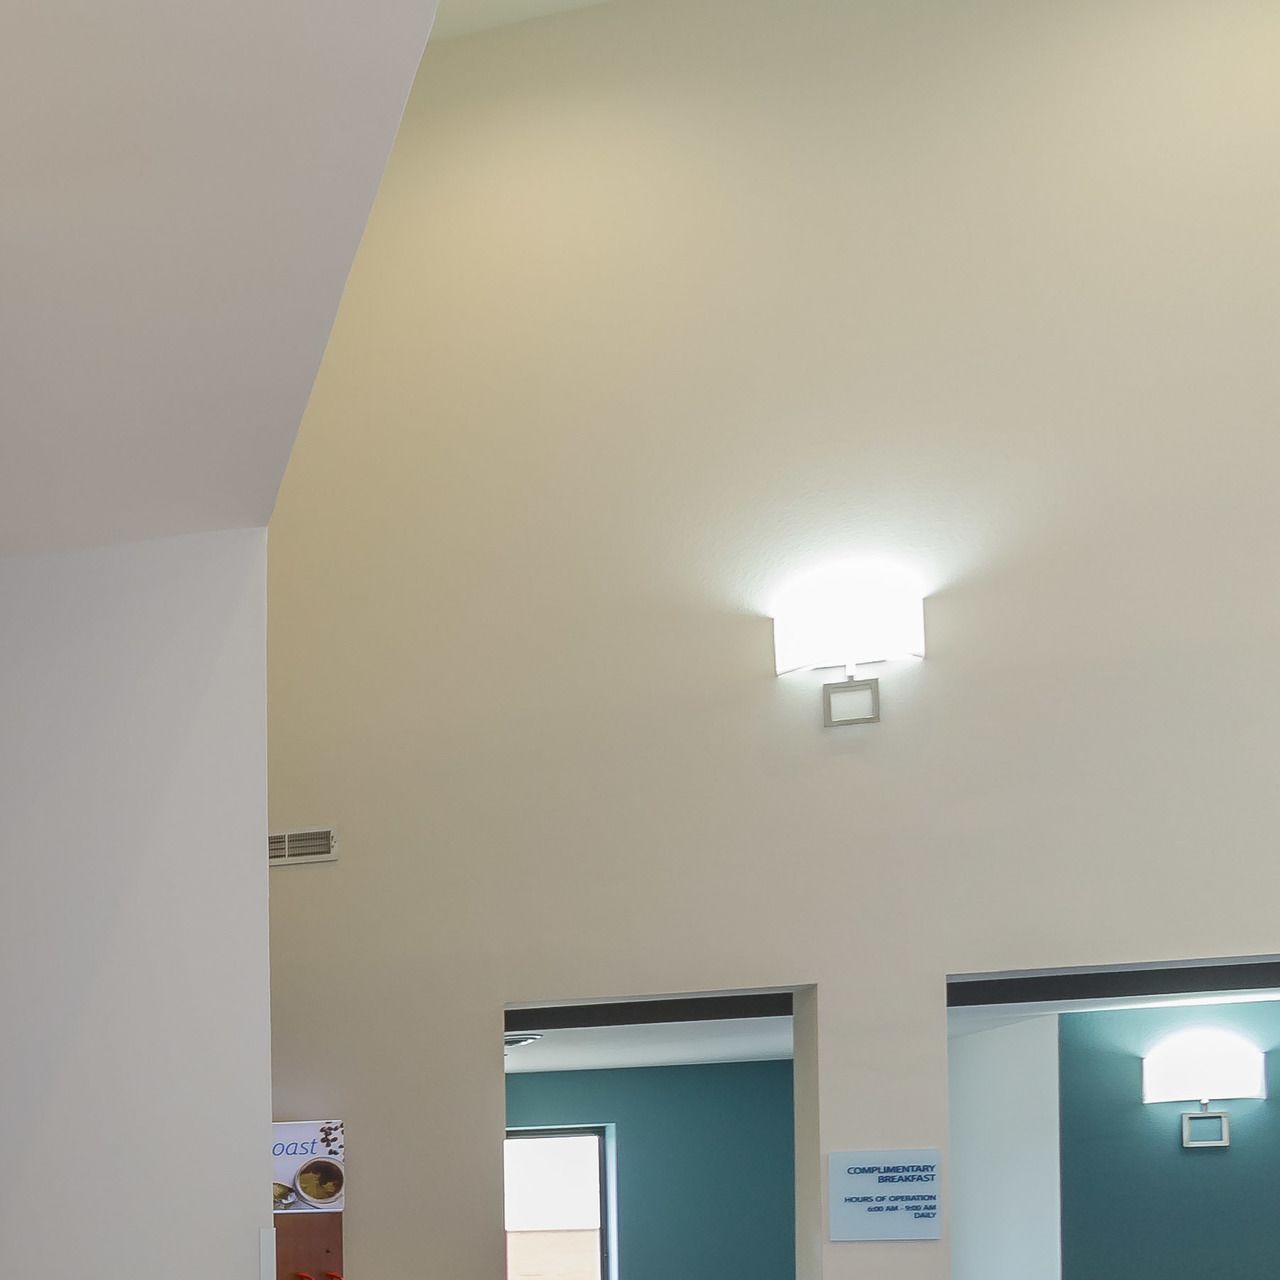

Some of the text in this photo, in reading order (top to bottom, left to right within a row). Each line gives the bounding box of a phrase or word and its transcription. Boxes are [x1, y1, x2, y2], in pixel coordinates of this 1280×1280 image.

[272, 1139, 318, 1156] oast
[847, 1164, 936, 1175] COMPLIMENTARY
[878, 1174, 936, 1183] BREAKFAST
